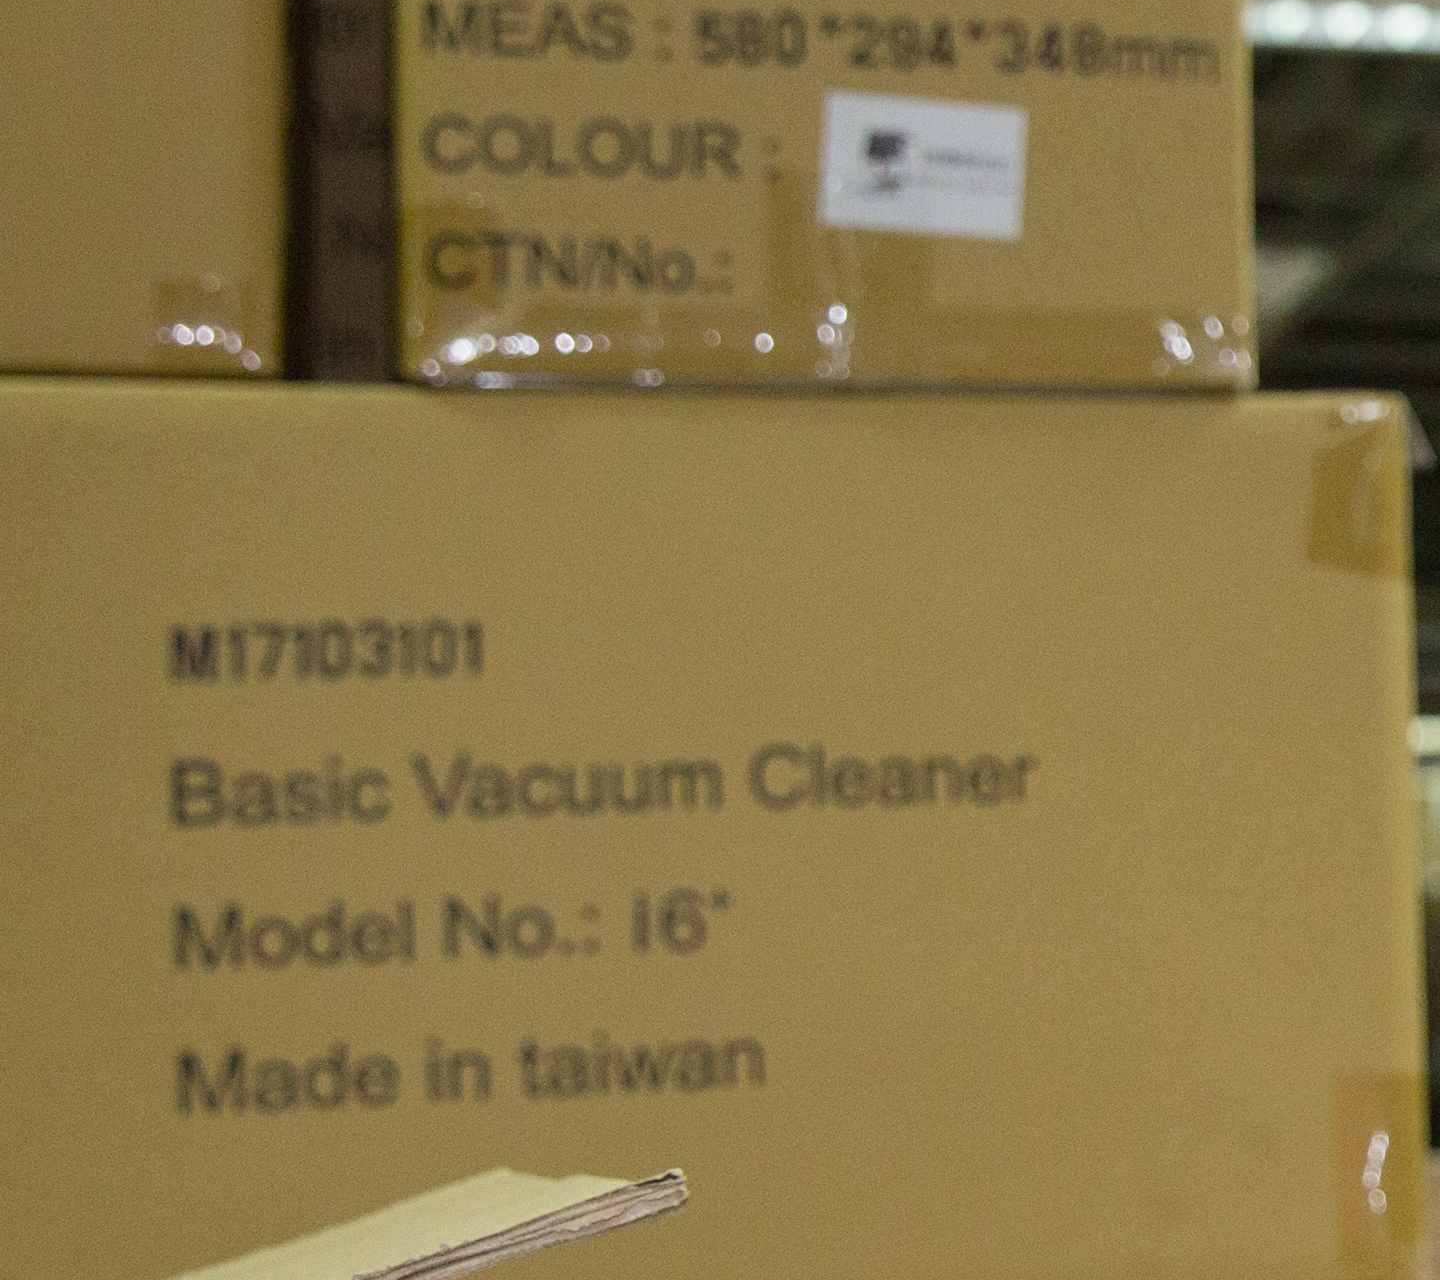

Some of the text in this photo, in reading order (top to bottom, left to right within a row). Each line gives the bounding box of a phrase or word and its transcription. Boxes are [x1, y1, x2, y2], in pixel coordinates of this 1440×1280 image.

[167, 619, 483, 683] M17103101
[166, 742, 1037, 830] Basic Vacuum Cleaner
[171, 902, 415, 972] Model
[174, 1030, 766, 1115] Made in taiwan
